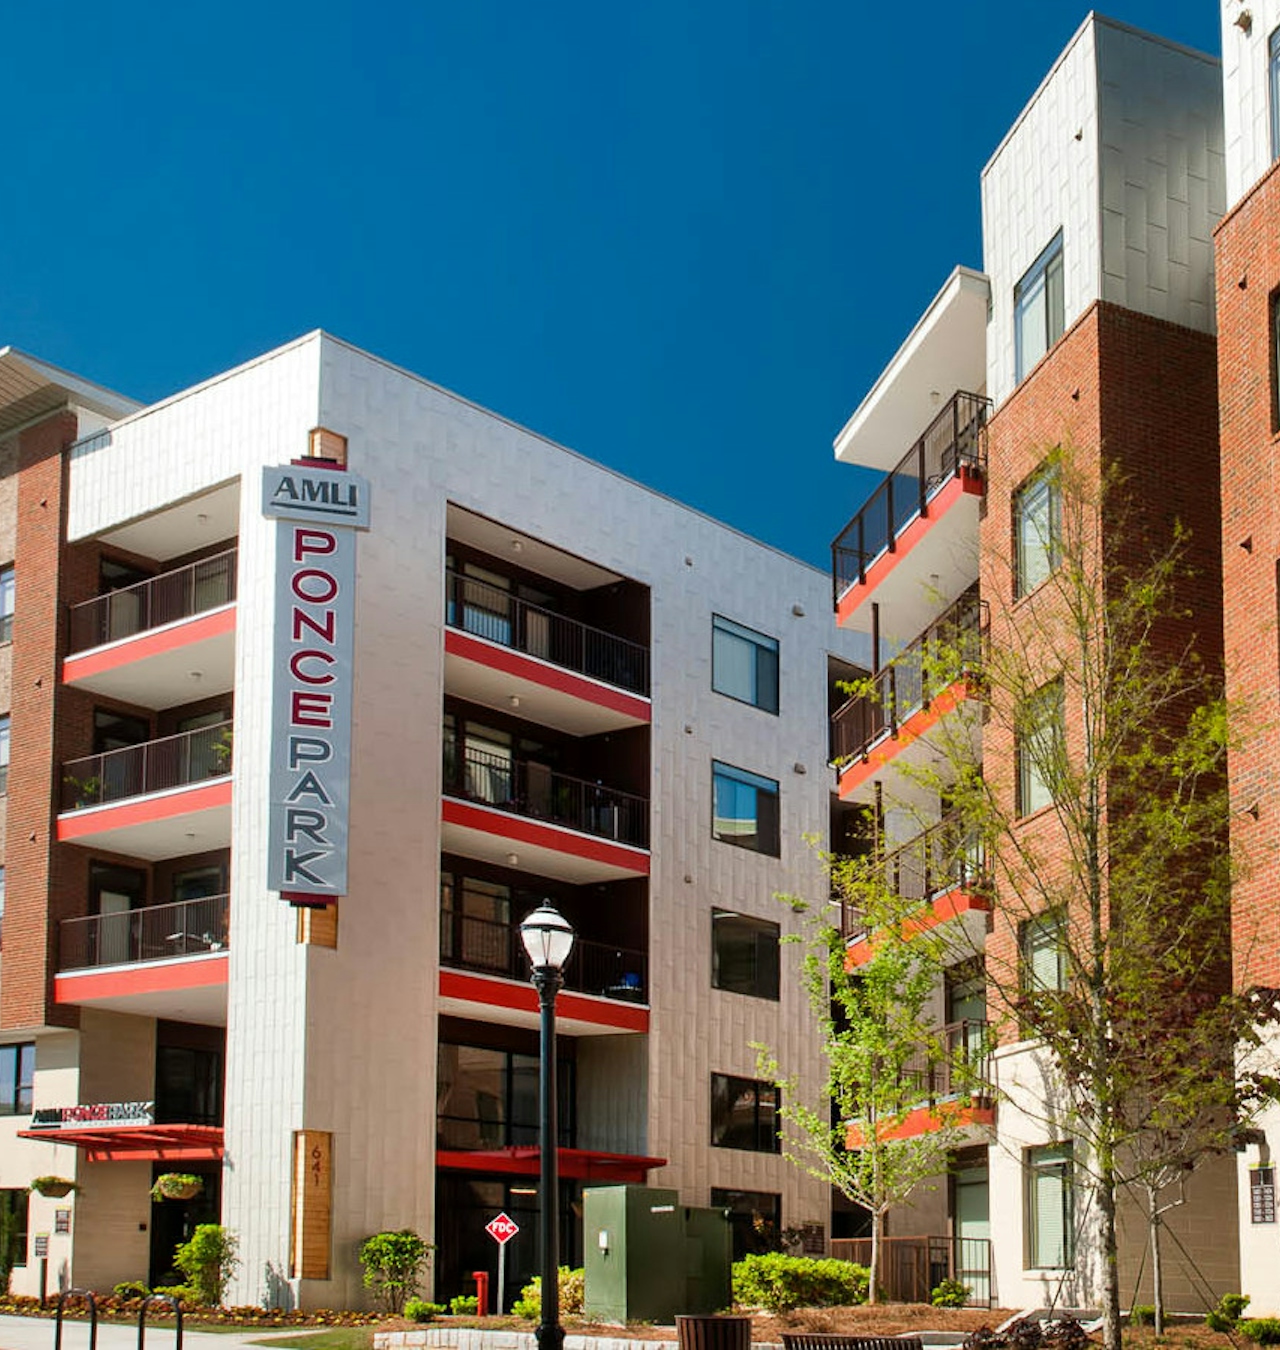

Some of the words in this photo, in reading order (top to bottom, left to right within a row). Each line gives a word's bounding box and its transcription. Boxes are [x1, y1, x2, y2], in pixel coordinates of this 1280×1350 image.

[273, 476, 357, 507] AMLI
[312, 1145, 321, 1187] 641
[492, 1221, 513, 1234] FDC
